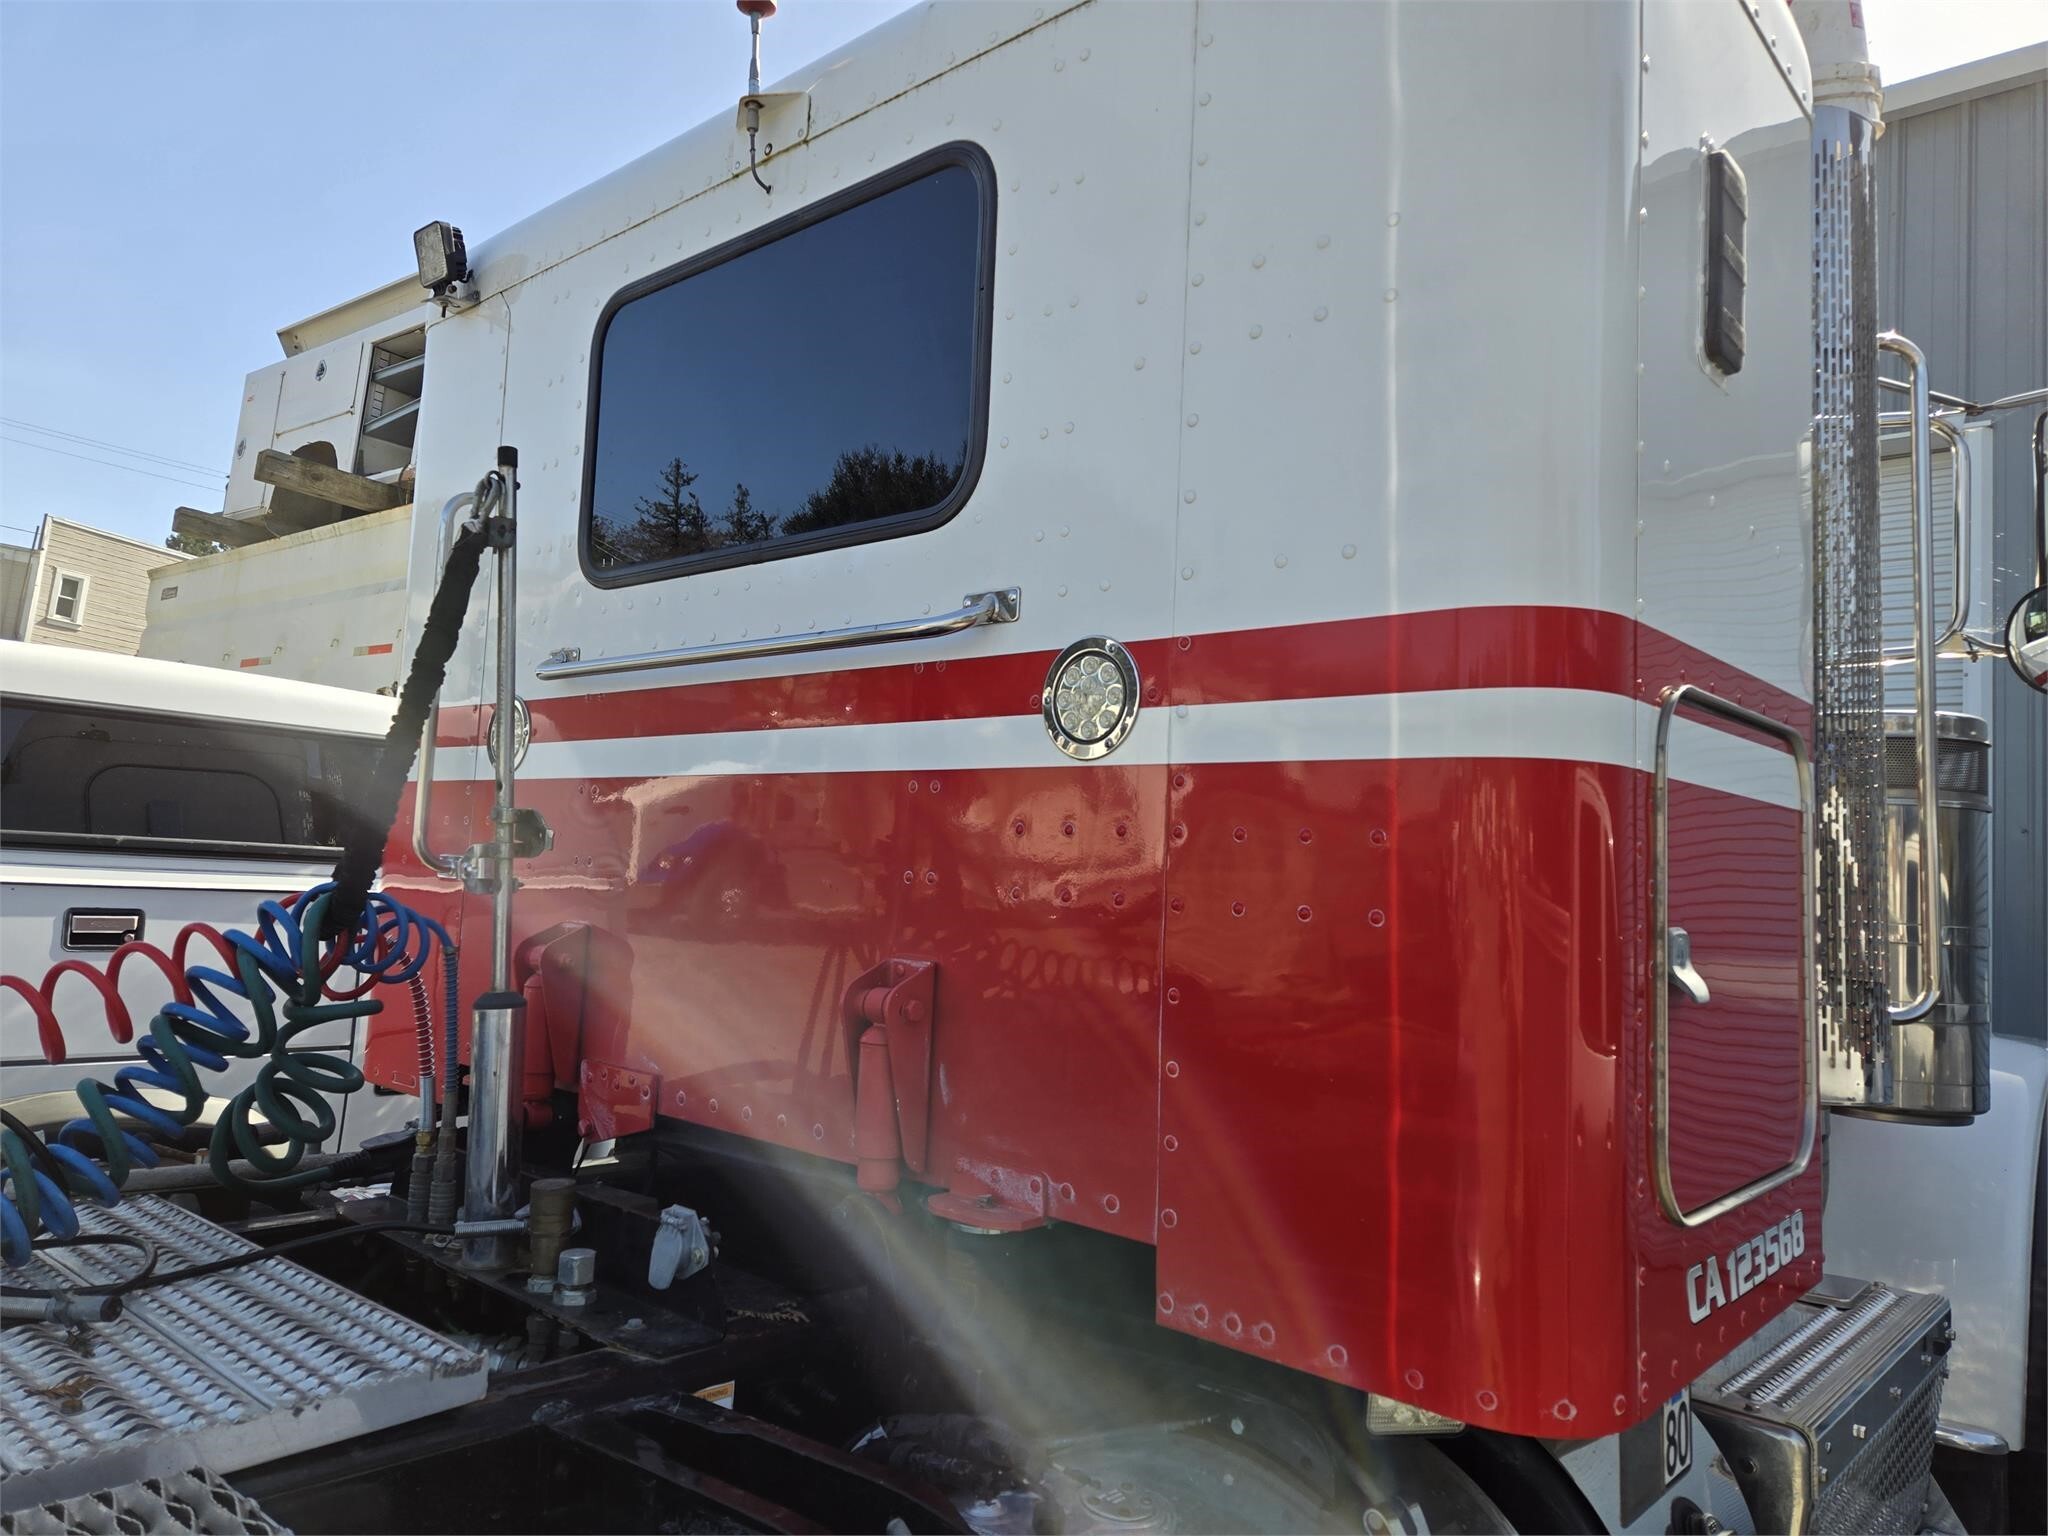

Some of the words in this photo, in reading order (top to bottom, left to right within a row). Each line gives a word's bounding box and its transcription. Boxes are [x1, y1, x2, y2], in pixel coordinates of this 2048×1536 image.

[1686, 1256, 1726, 1324] CA
[1727, 1211, 1804, 1302] 123568
[1666, 1401, 1689, 1477] 80
